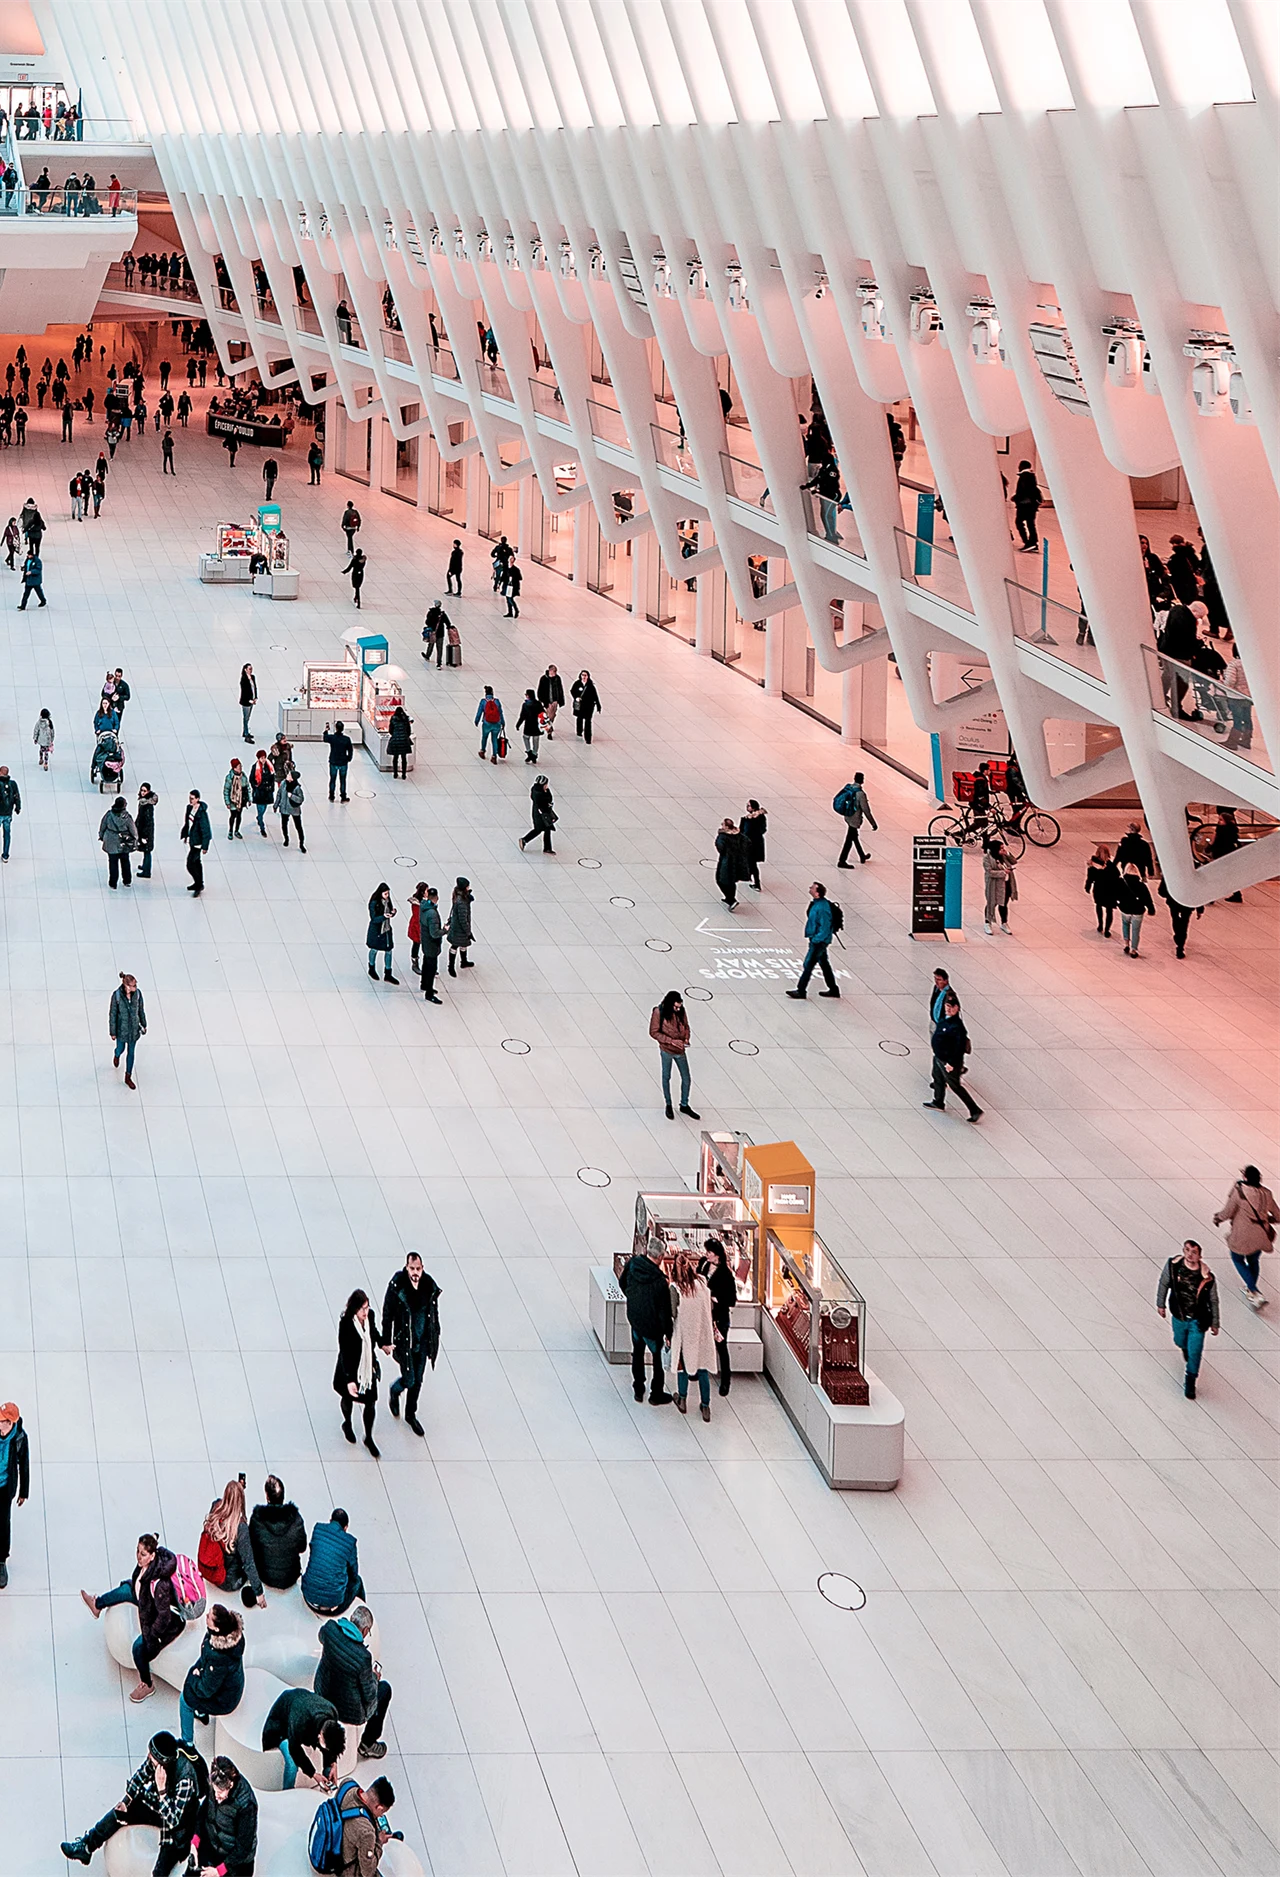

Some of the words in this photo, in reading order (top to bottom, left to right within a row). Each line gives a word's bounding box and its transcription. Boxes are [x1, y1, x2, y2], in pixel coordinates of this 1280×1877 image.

[236, 425, 254, 437] OULUD
[958, 735, 980, 743] Oculus
[713, 958, 766, 969] WAY
[699, 968, 780, 980] SHOPS
